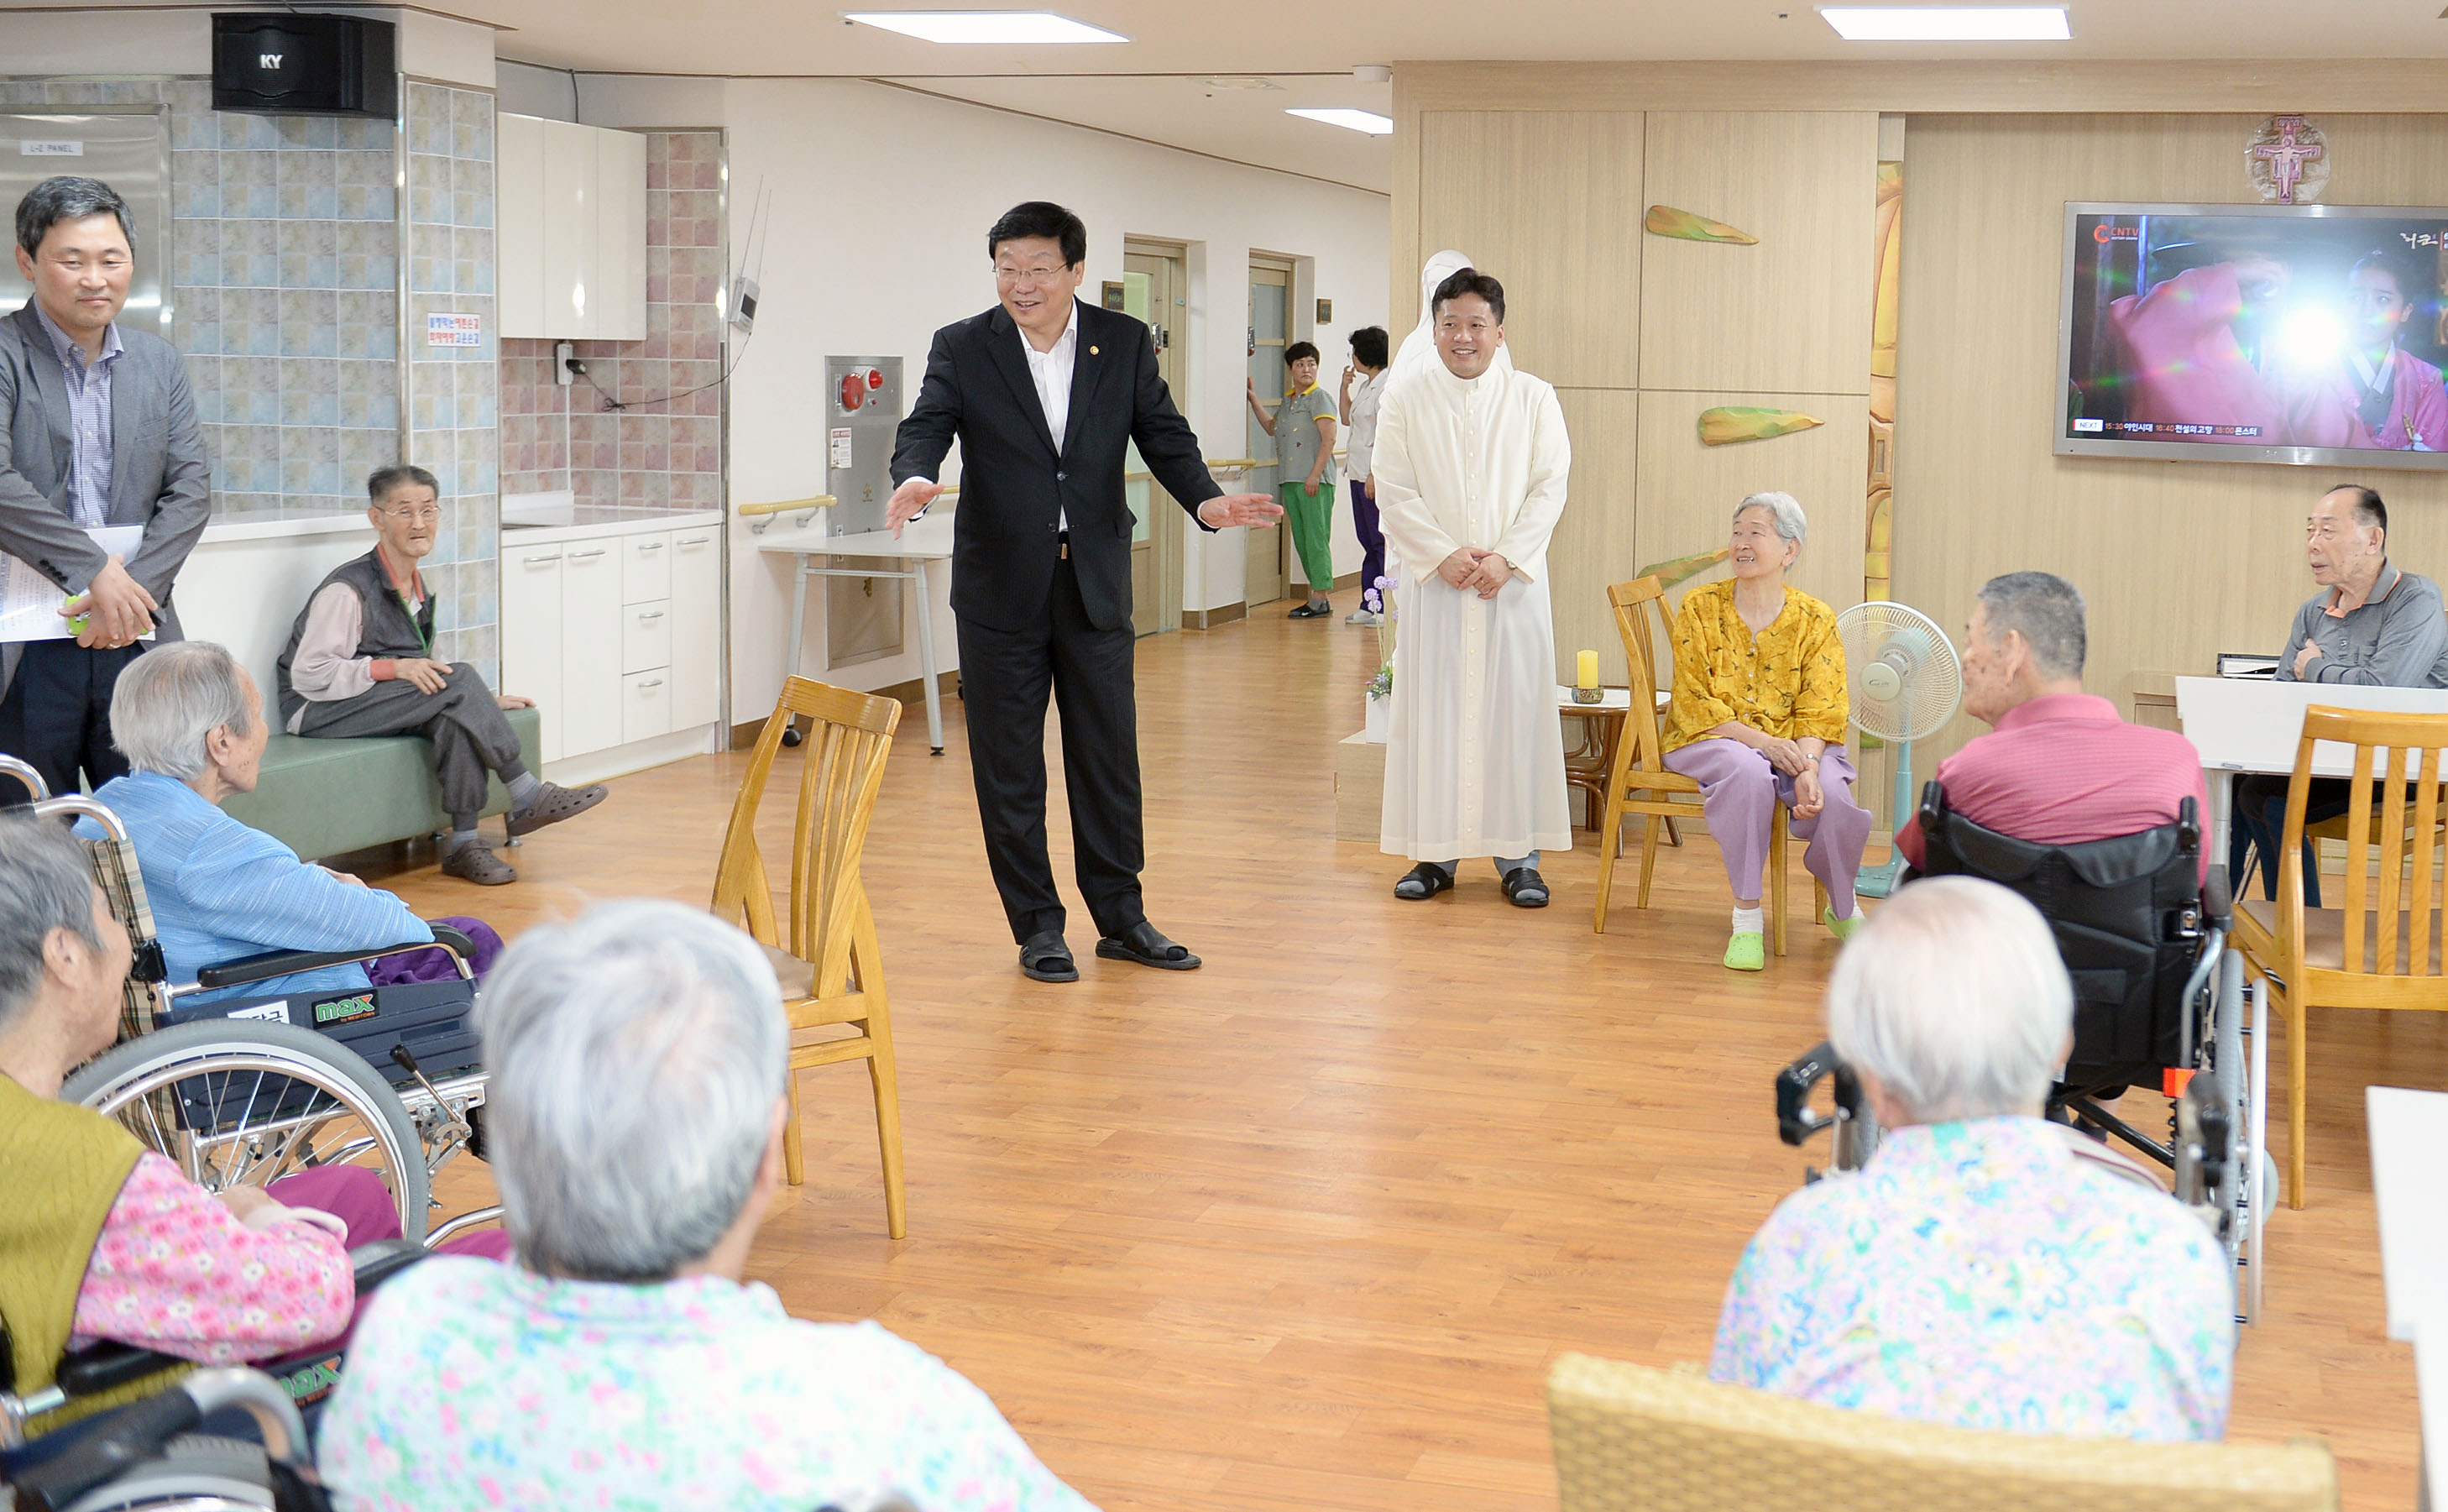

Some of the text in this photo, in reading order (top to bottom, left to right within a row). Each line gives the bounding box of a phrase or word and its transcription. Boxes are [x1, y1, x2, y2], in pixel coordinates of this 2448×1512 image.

[260, 54, 284, 70] KY
[47, 144, 74, 153] PANEL
[2111, 227, 2139, 237] CNTV
[2105, 422, 2124, 431] 15:30
[316, 994, 375, 1022] max
